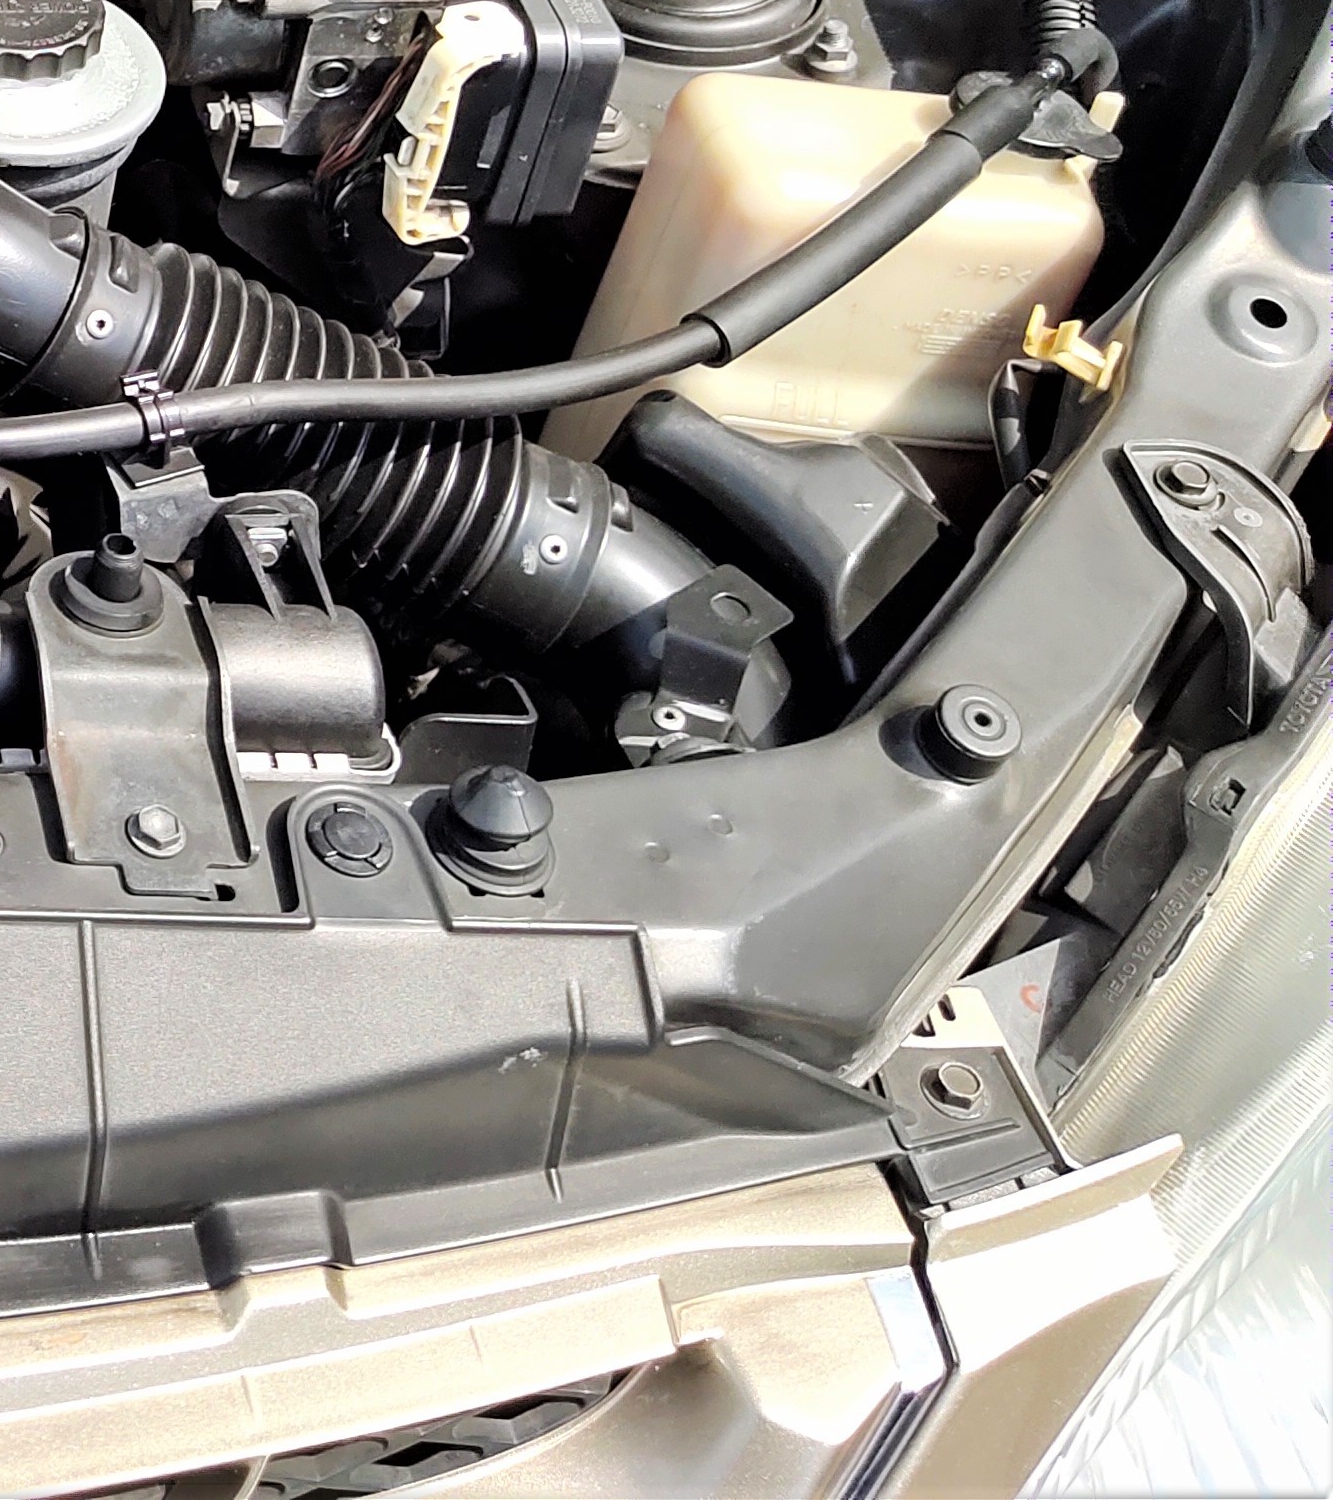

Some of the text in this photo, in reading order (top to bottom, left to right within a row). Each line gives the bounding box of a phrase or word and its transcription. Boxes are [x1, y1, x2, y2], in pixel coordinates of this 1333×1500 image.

[30, 2, 90, 14] POWER
[771, 381, 849, 426] FULL
[1103, 963, 1137, 1002] HEAD
